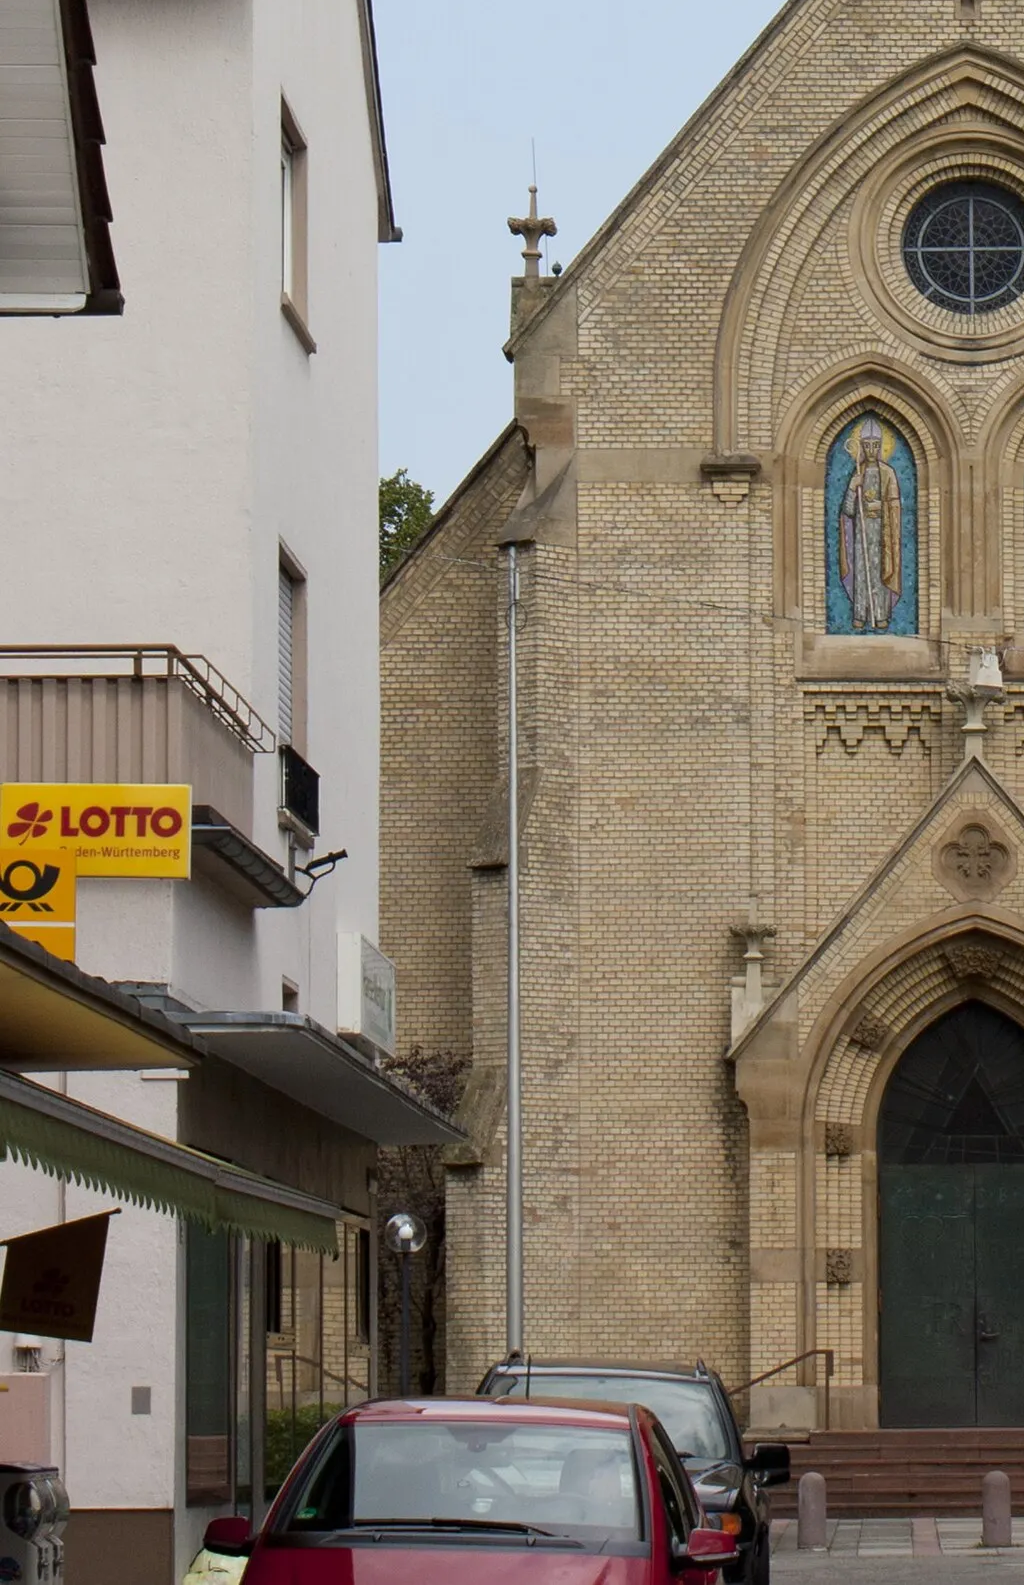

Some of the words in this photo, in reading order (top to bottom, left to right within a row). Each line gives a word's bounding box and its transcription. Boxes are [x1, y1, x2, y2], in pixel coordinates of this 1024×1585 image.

[60, 805, 183, 838] LOTTO
[60, 846, 180, 860] den-Württemberg
[20, 1297, 75, 1317] LOTTO
